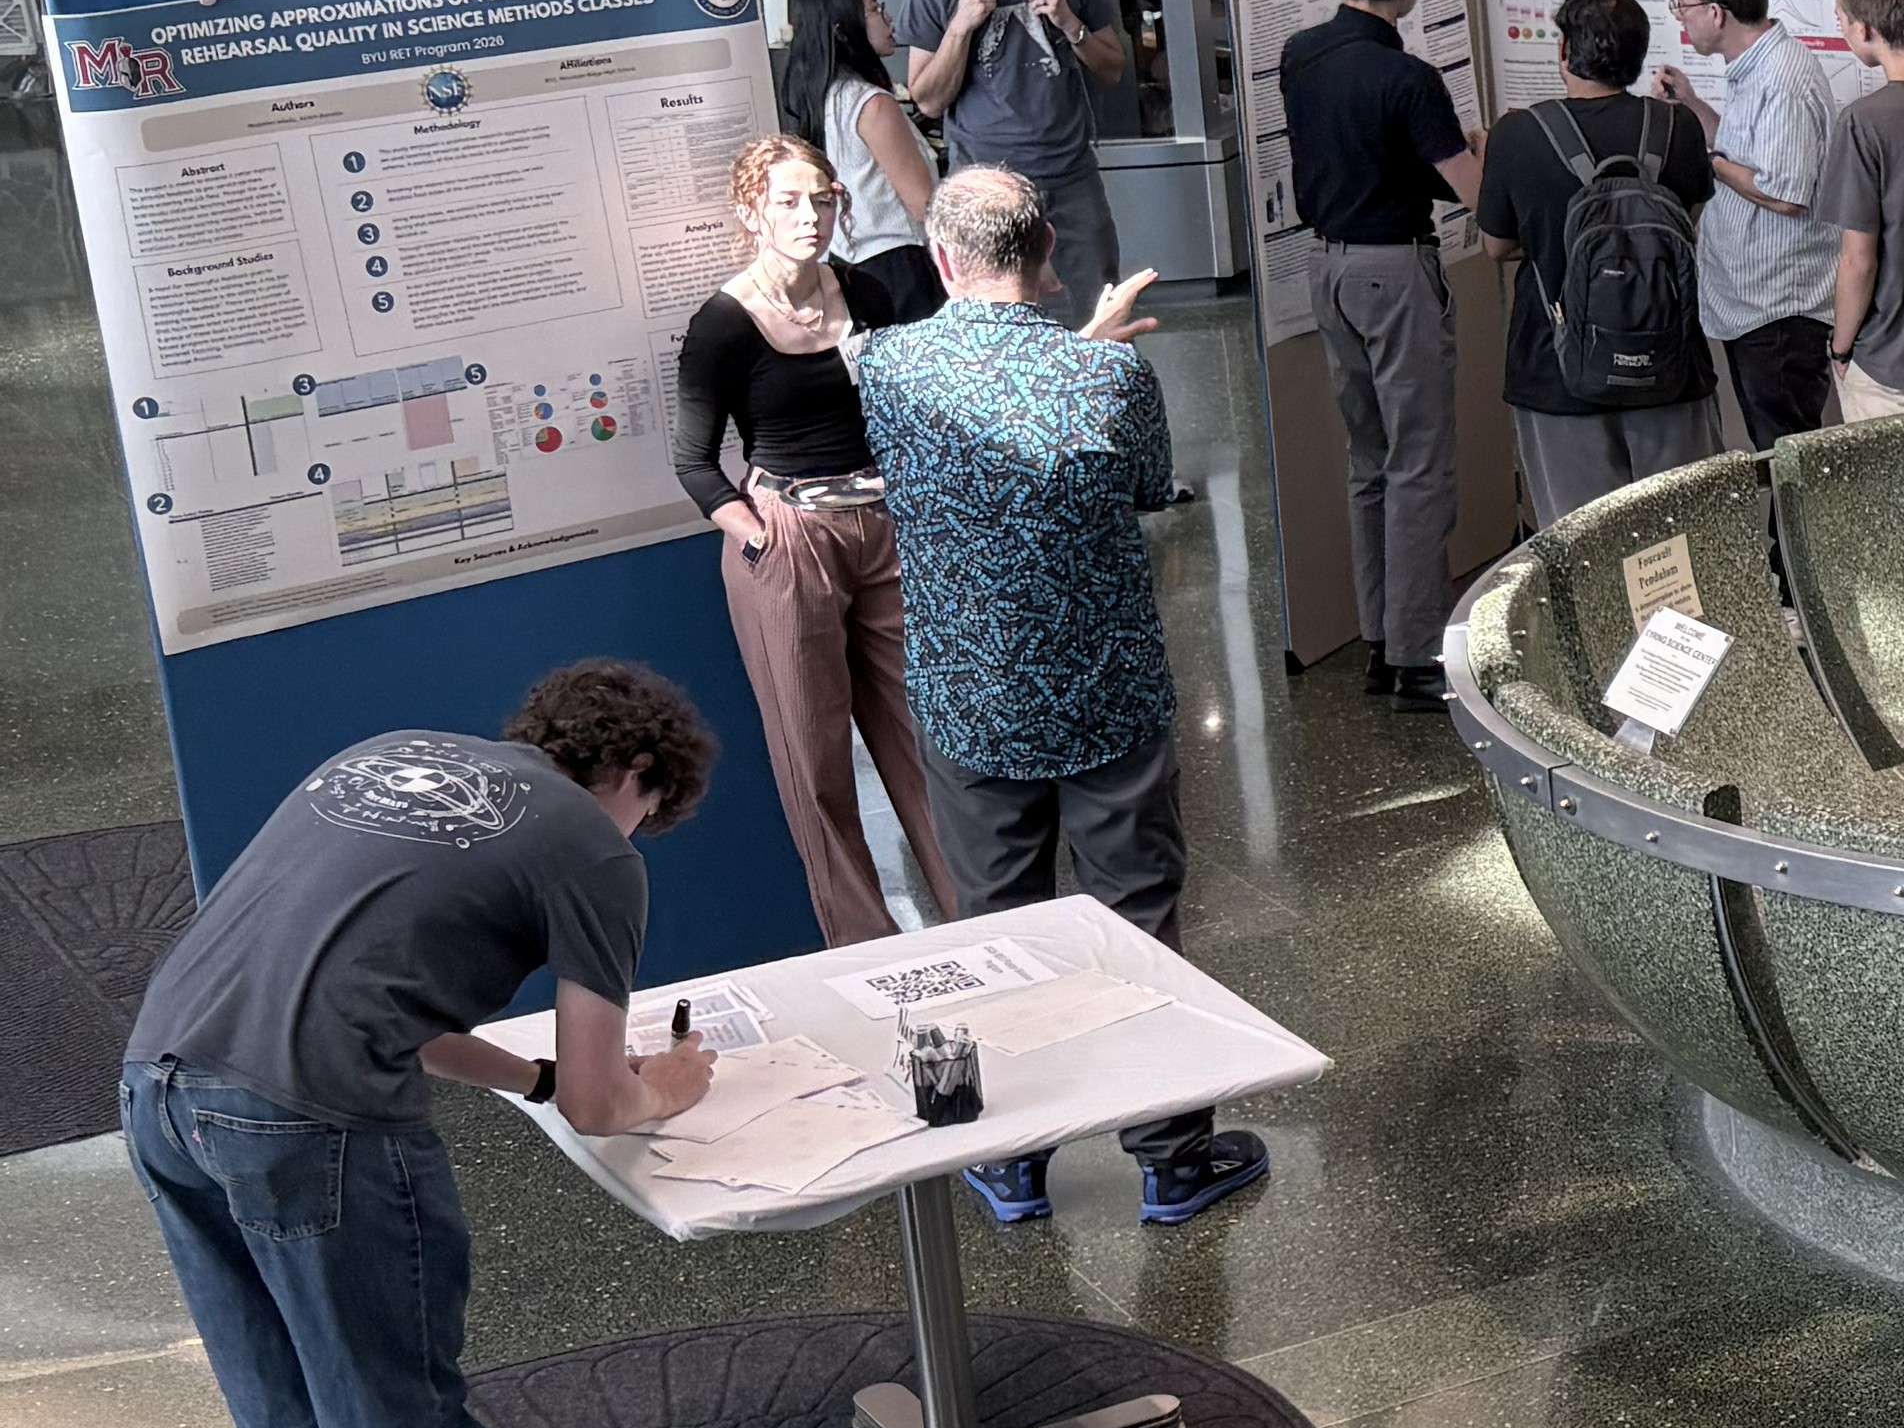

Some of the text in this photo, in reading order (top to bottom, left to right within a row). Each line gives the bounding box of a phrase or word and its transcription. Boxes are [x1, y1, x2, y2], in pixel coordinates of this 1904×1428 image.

[151, 14, 265, 45] OPTIMIZING
[181, 36, 292, 66] REHEARSAL
[296, 27, 378, 52] QUALITY
[382, 21, 403, 39] IN
[408, 14, 485, 36] SCIENCE
[488, 0, 574, 24] METHODS
[361, 52, 387, 64] BYU
[390, 48, 412, 61] RET
[415, 39, 471, 59] Program
[660, 93, 704, 108] Results
[357, 194, 368, 209] 2
[363, 227, 373, 241] 3
[378, 295, 388, 309] 5
